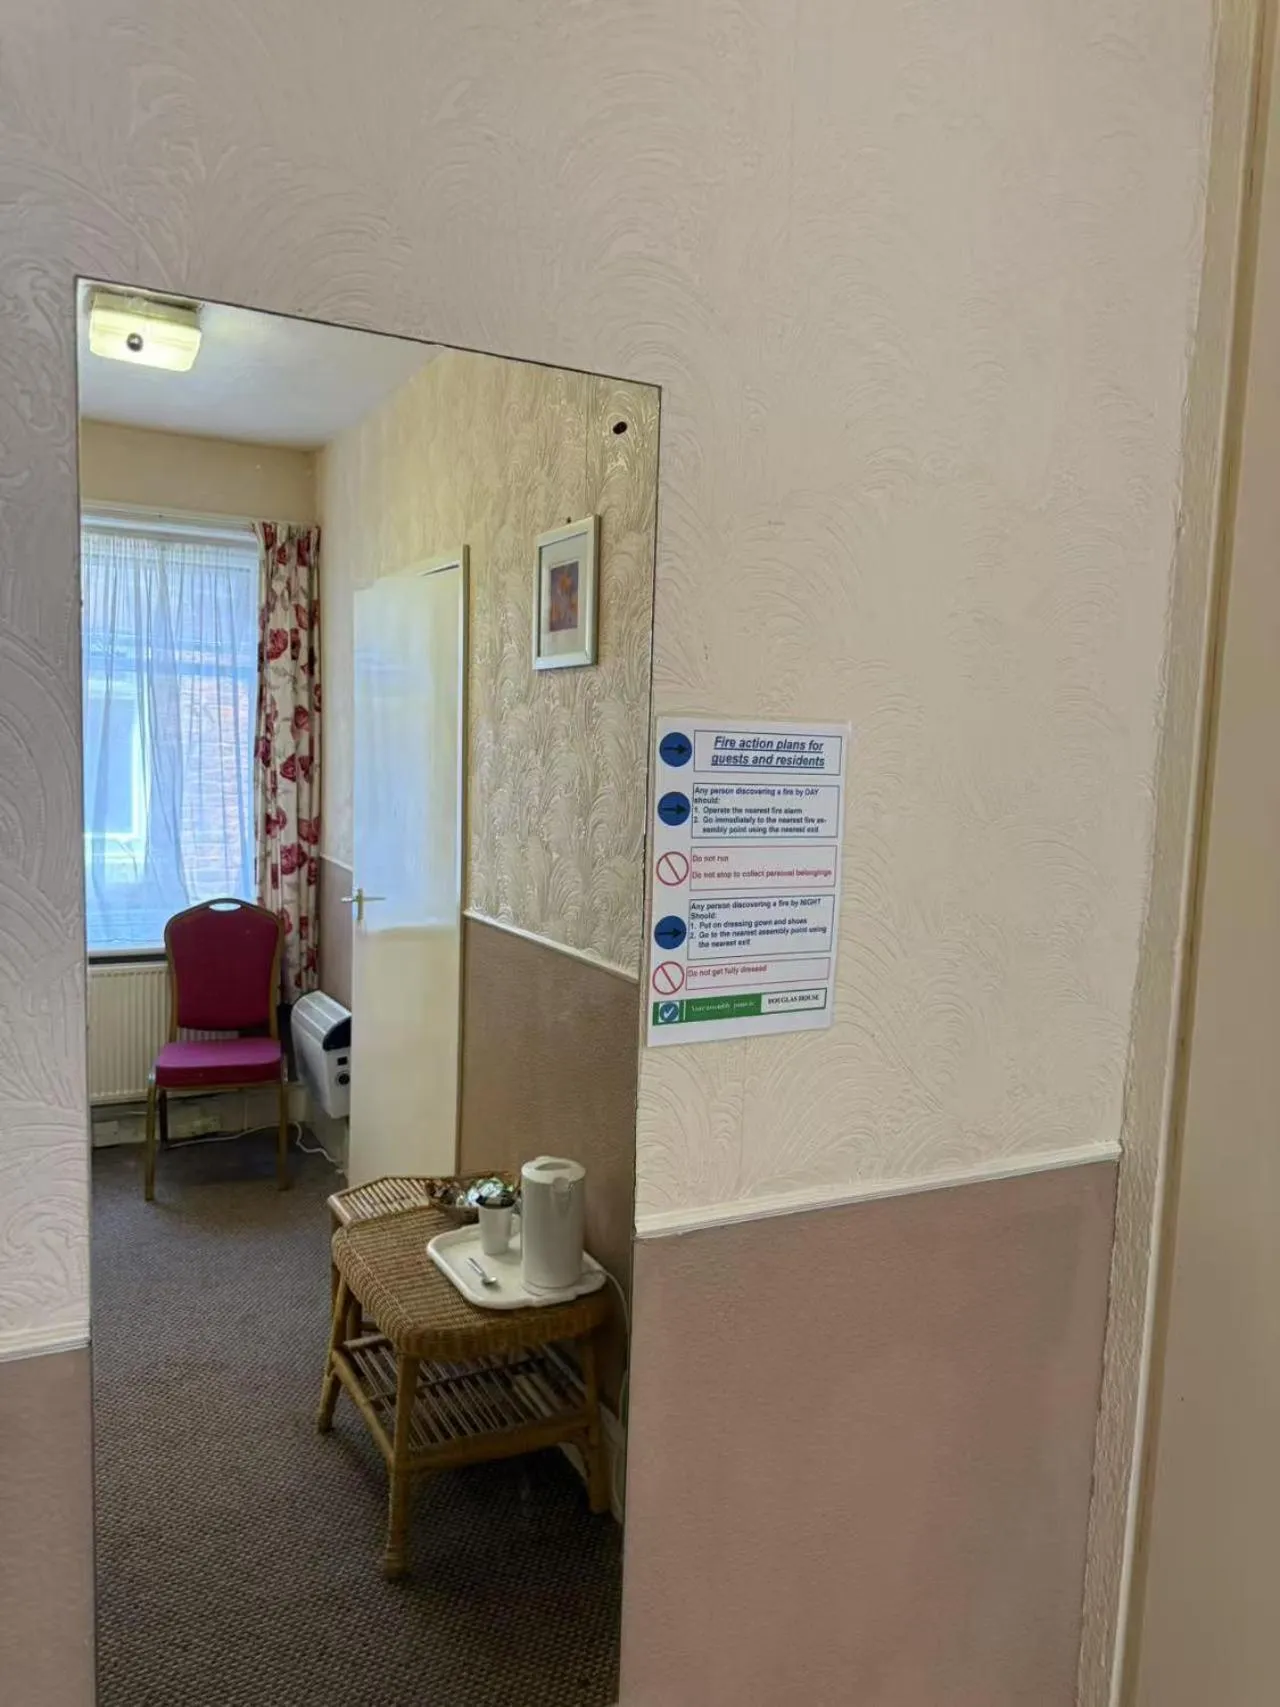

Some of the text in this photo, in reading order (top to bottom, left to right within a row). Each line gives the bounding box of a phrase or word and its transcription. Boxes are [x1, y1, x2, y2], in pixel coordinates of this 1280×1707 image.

[714, 736, 824, 753] Fire action plans for
[712, 753, 824, 766] guests and residents
[695, 787, 708, 795] Any
[795, 789, 803, 797] by
[703, 807, 729, 815] Operate
[796, 869, 832, 877] belongings
[691, 902, 704, 911] Any
[732, 901, 771, 909] discovering
[791, 900, 798, 908] by
[758, 928, 789, 936] assembly
[713, 968, 723, 977] get
[725, 966, 739, 975] fully
[740, 965, 767, 973] dressed
[768, 997, 797, 1005] DOUGLAS
